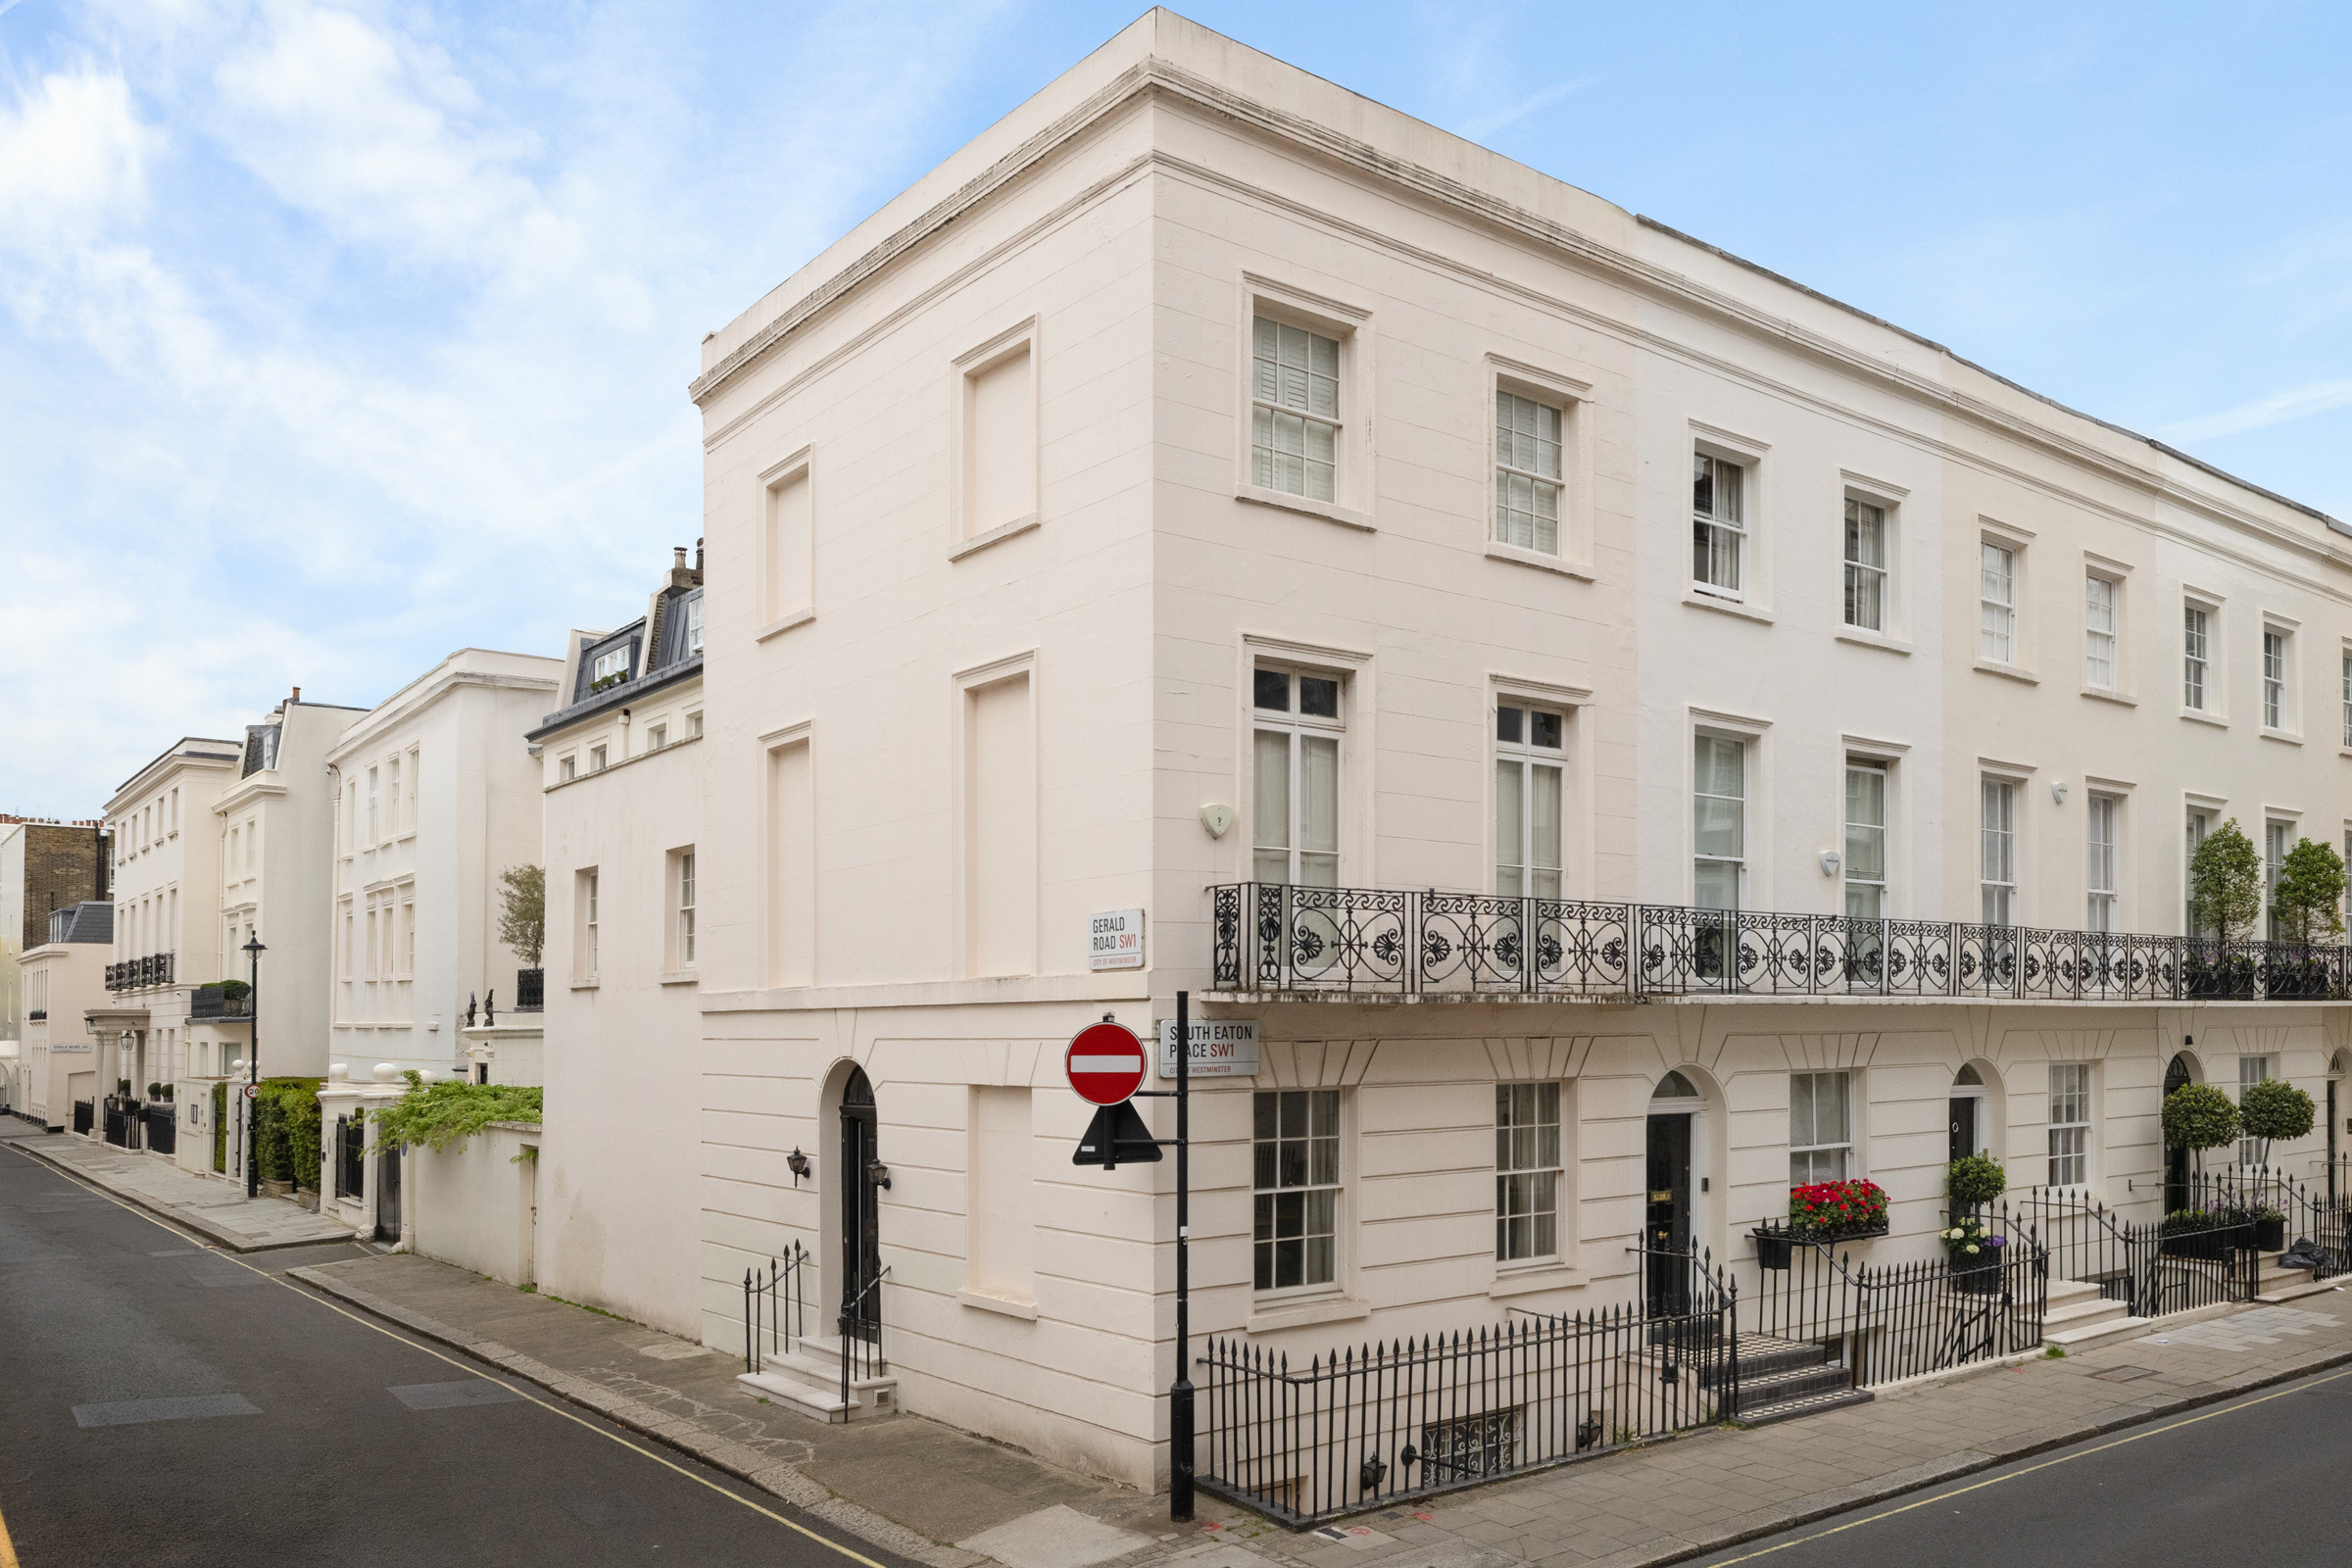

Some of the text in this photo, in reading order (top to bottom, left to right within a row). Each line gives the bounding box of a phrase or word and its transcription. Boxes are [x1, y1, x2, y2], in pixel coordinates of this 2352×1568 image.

[1093, 917, 1125, 933] GERALD
[1093, 933, 1137, 952] ROAD SW1
[1109, 956, 1137, 965] WESTMINSTER
[1169, 1025, 1252, 1041] SUTH EATON
[1169, 1043, 1235, 1058] PACE SW1
[1192, 1065, 1232, 1074] WESTMINSTER
